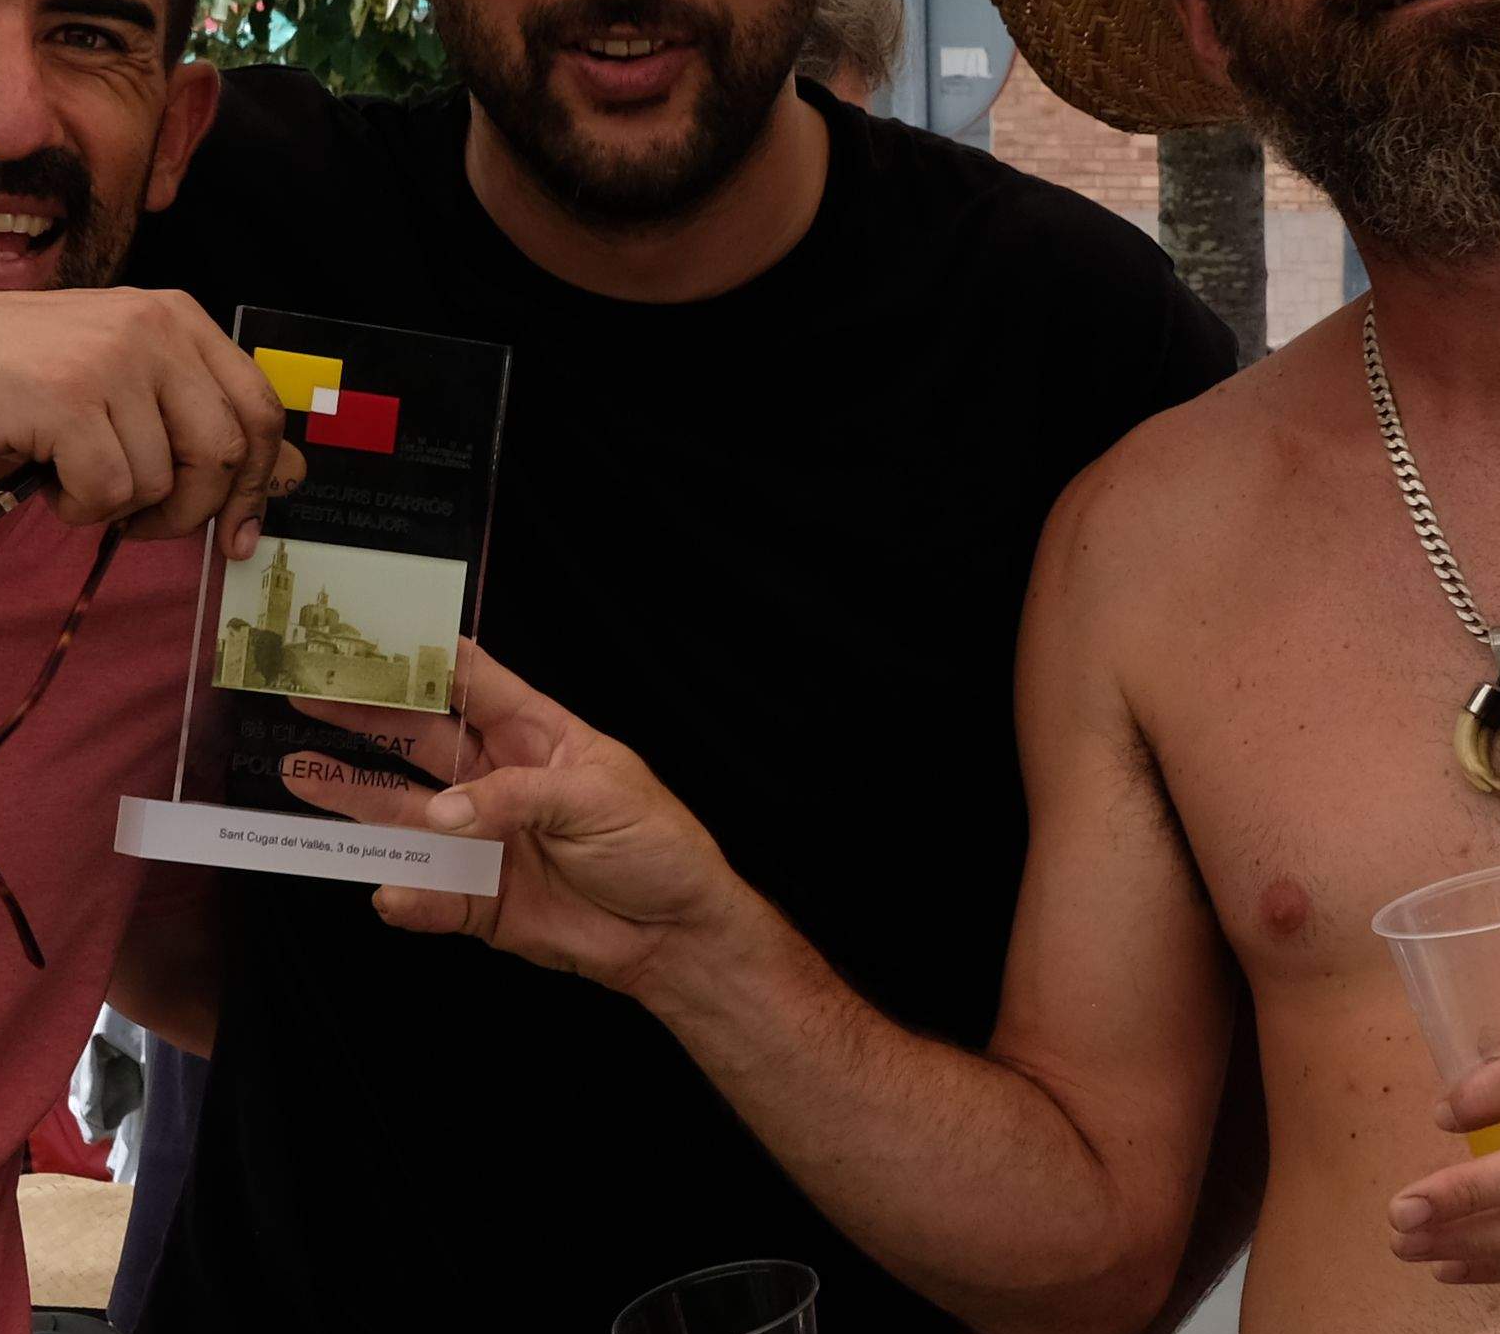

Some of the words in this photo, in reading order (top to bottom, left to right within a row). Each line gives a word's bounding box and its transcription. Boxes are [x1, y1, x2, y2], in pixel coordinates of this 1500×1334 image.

[285, 477, 372, 505] CONCURS
[288, 504, 344, 526] FESTA
[347, 510, 410, 534] MAJOR
[273, 723, 416, 756] CLASSIFICAT
[231, 753, 346, 784] POLLERIA
[350, 769, 410, 792] IMMA
[220, 828, 244, 841] Sant
[246, 831, 279, 846] Cugat
[281, 835, 298, 847] del
[337, 842, 344, 853] 3
[346, 843, 360, 855] de
[361, 846, 386, 859] juliol
[389, 848, 402, 860] de
[404, 851, 431, 864] 2022
